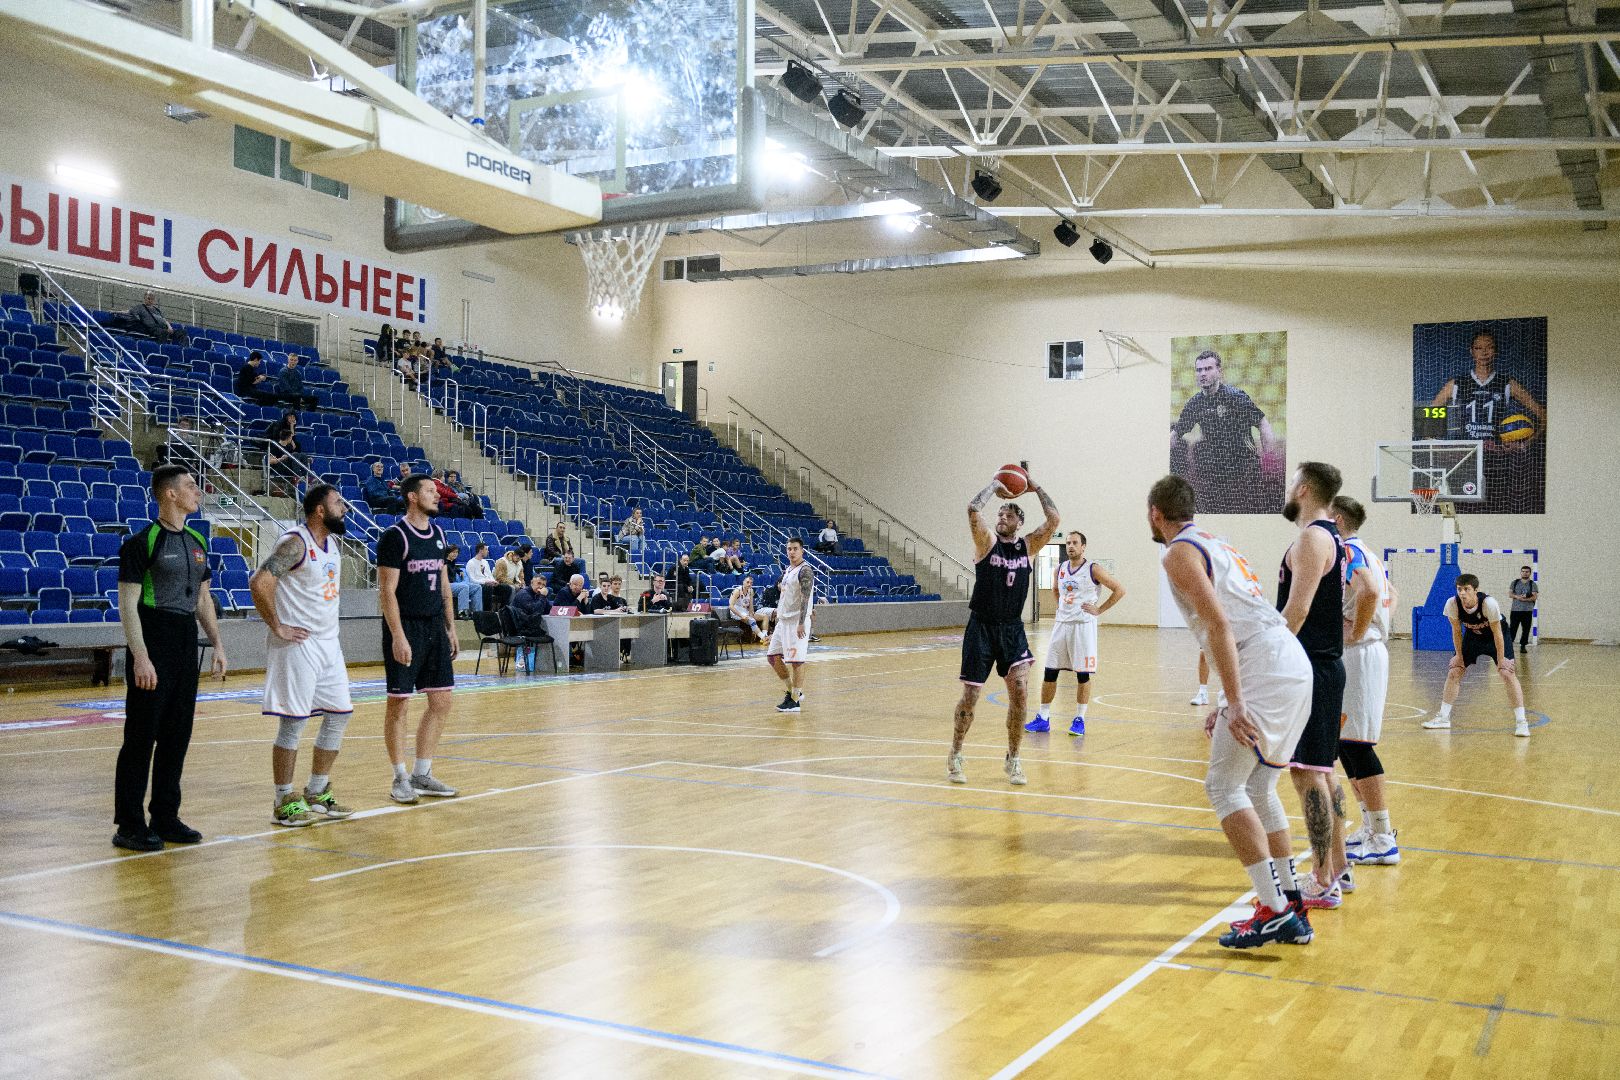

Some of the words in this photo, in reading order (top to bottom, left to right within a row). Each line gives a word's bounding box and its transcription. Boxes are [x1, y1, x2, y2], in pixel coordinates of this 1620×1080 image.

[0, 183, 173, 274] ЫШЕ!
[197, 228, 426, 324] СИЛЬНЕЕ!
[1465, 399, 1494, 423] 11
[407, 559, 445, 574] ФРЯЗИ
[427, 573, 437, 591] 7
[1006, 571, 1016, 587] 0
[1084, 656, 1096, 669] 13
